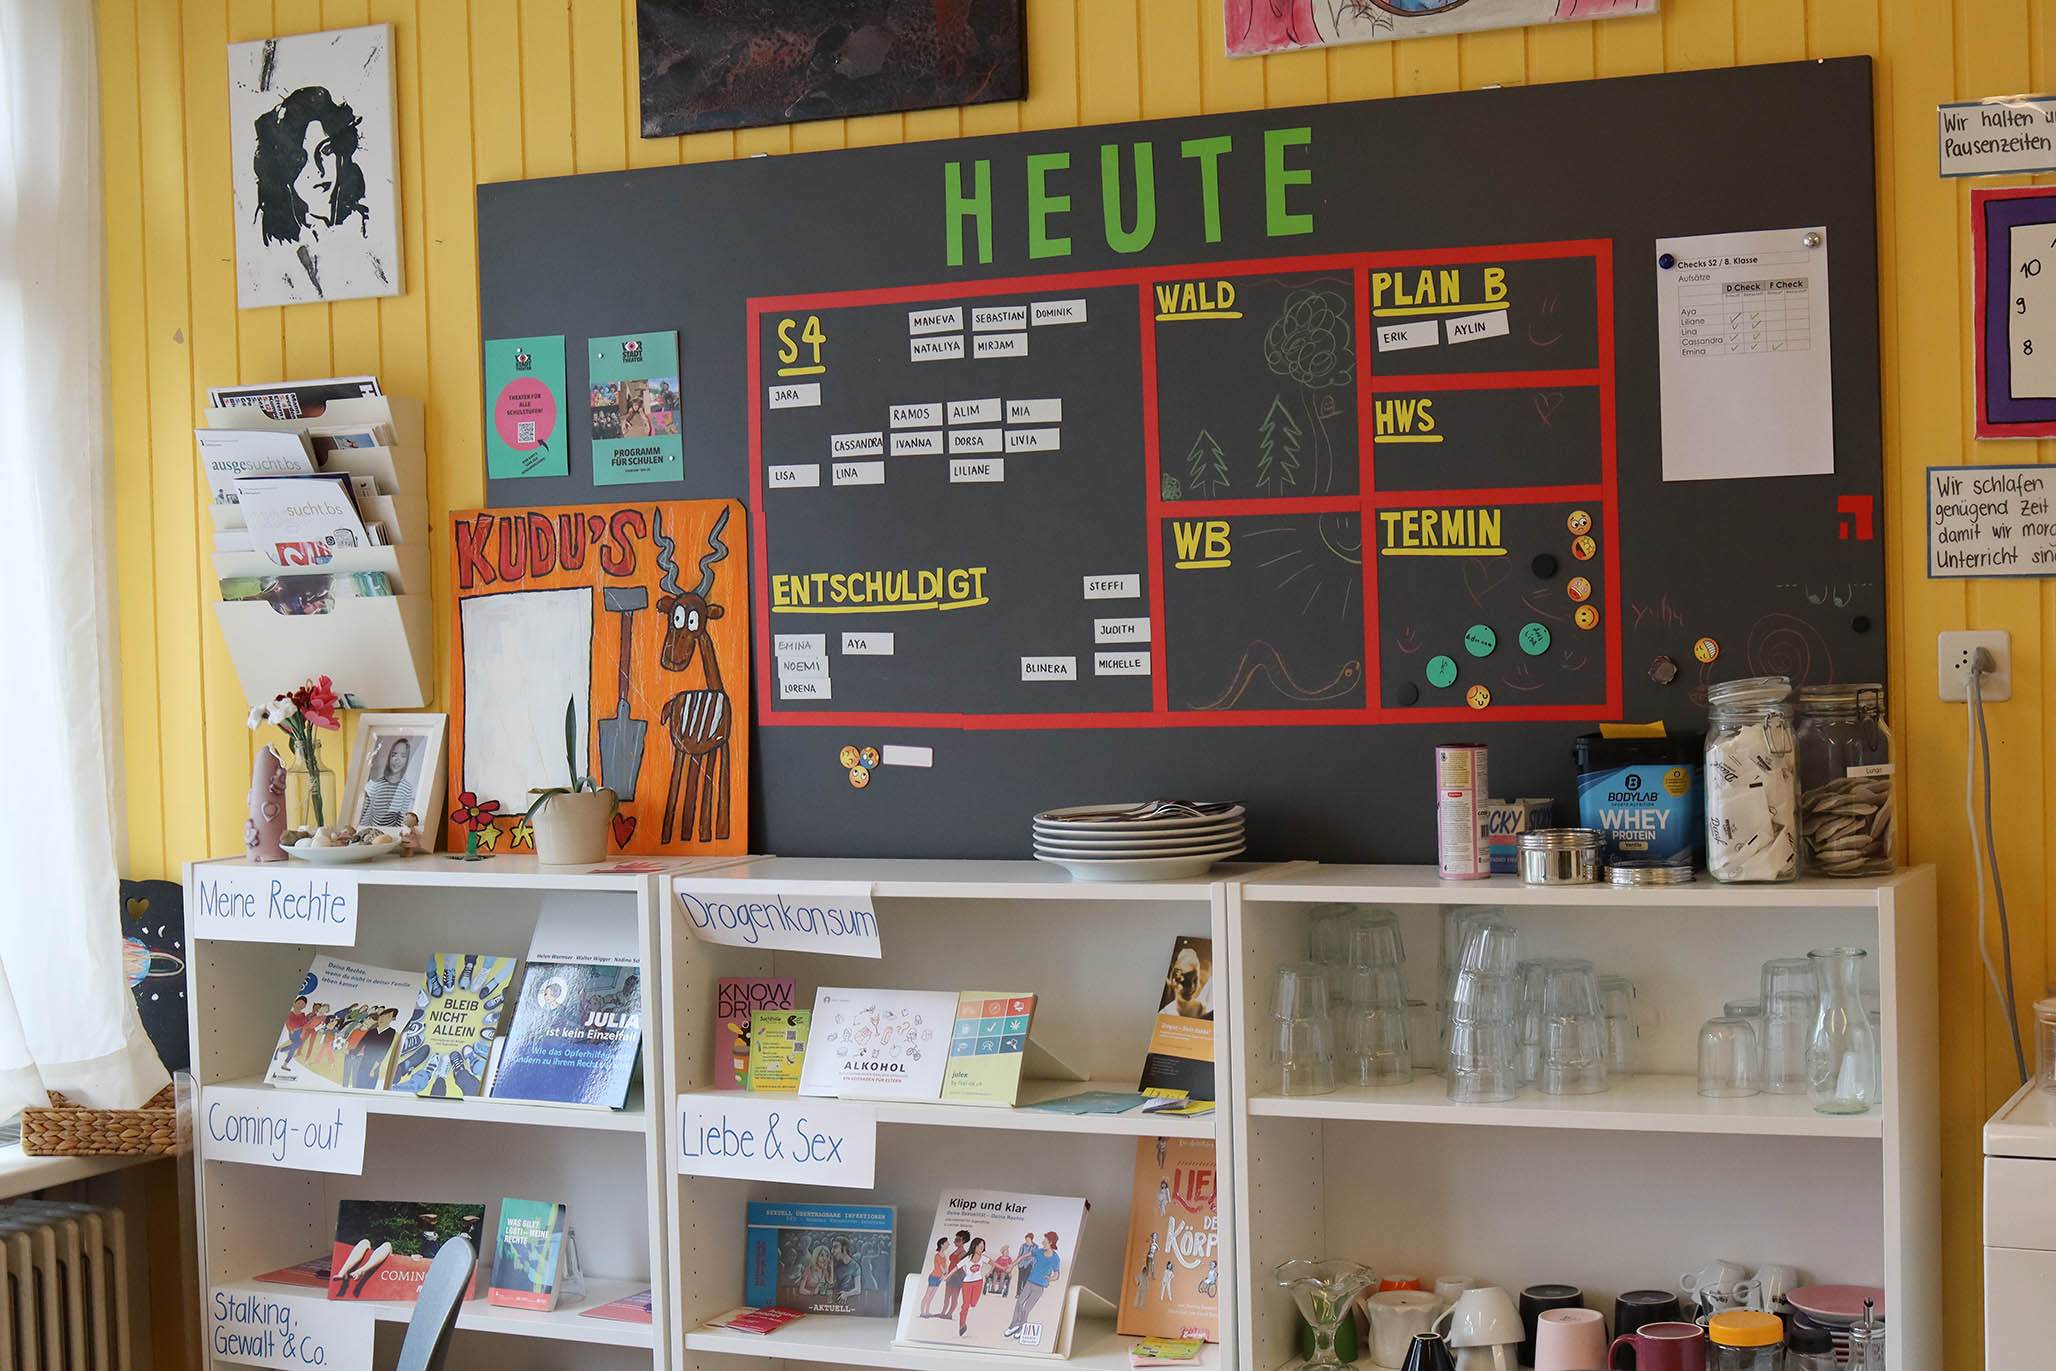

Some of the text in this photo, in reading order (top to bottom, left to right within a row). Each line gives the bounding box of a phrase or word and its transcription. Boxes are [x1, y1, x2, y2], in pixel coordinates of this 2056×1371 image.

[1943, 110, 2056, 133] Wir halten u
[1944, 132, 2051, 158] Pausenzeiten
[945, 127, 1314, 266] HEUTE
[1677, 260, 1707, 270] Checks
[1708, 259, 1718, 267] S2
[1733, 256, 1759, 266] Klasse
[2019, 258, 2042, 279] 10
[1677, 273, 1711, 283] Aufsätze
[1734, 282, 1761, 291] Check
[1776, 280, 1804, 289] Check
[1372, 267, 1508, 308] PLAN B
[1156, 280, 1236, 314] WALD
[1681, 308, 1697, 316] Aya
[2016, 297, 2026, 315] 9
[913, 306, 1073, 327] MANEVA SEBASTIAN DOMINIK
[1681, 317, 1705, 326] Liliane
[776, 314, 827, 364] S4
[1384, 321, 1487, 345] ERIK AYLIN
[1681, 327, 1698, 336] Lina
[913, 339, 1014, 355] NATALIYA MIRJAM
[1681, 336, 1724, 346] Cassandra
[2022, 339, 2034, 356] 8
[622, 350, 643, 359] STADT
[1681, 347, 1707, 356] Emina
[774, 389, 799, 402] JARA
[893, 404, 1031, 421] RAMOS ALIM MIA
[1374, 398, 1436, 435] HWS
[834, 435, 1038, 451] CASSANDRA IVANNA DORSA LIVIA
[613, 446, 661, 458] PROGRAMM
[211, 456, 303, 475] ausgesucht.bs
[611, 455, 664, 467] FÜR SCHULEN
[774, 464, 991, 481] LISA LINA LILIANE
[1936, 473, 2044, 498] Wir schlafen
[1935, 498, 2009, 526] genügend
[1379, 508, 1502, 548] TERMIN
[1938, 523, 1982, 544] damit
[1991, 522, 2013, 539] wir
[455, 508, 647, 590] KUDU'S
[1172, 520, 1233, 561] WB
[1936, 545, 2019, 569] Unterricht
[772, 567, 988, 606] ENTSCHULDIGT
[1089, 580, 1124, 592] STEFFI
[1099, 624, 1135, 635] JUDITH
[777, 639, 868, 651] EMINA AYA
[1025, 658, 1142, 675] BLINERA MICHELLE
[784, 683, 817, 694] LORENA
[1607, 791, 1658, 802] BODYLAB
[1599, 808, 1671, 830] WHEY
[1612, 830, 1656, 840] PROTEIN
[200, 879, 346, 924] Meine Rechte
[680, 891, 879, 944] Drogenkonsum
[718, 983, 792, 1001] KNOW
[444, 998, 479, 1011] BLEIB
[429, 1010, 468, 1023] NICHT
[584, 1010, 640, 1029] JULIA
[432, 1024, 476, 1038] ALLEIN
[546, 1027, 637, 1041] ist kein Einzelfall
[532, 1047, 562, 1056] Wie das
[552, 1059, 576, 1067] ihrem
[844, 1061, 907, 1073] ALKOHOL
[208, 1101, 344, 1162] Coming-out
[681, 1111, 844, 1163] Liebe & Sex
[1172, 1168, 1217, 1214] LIE
[949, 1198, 1028, 1213] Klipp und klar
[507, 1217, 522, 1227] WAS
[213, 1292, 299, 1338] Stalking,
[213, 1329, 328, 1367] Gewalt & Co.
